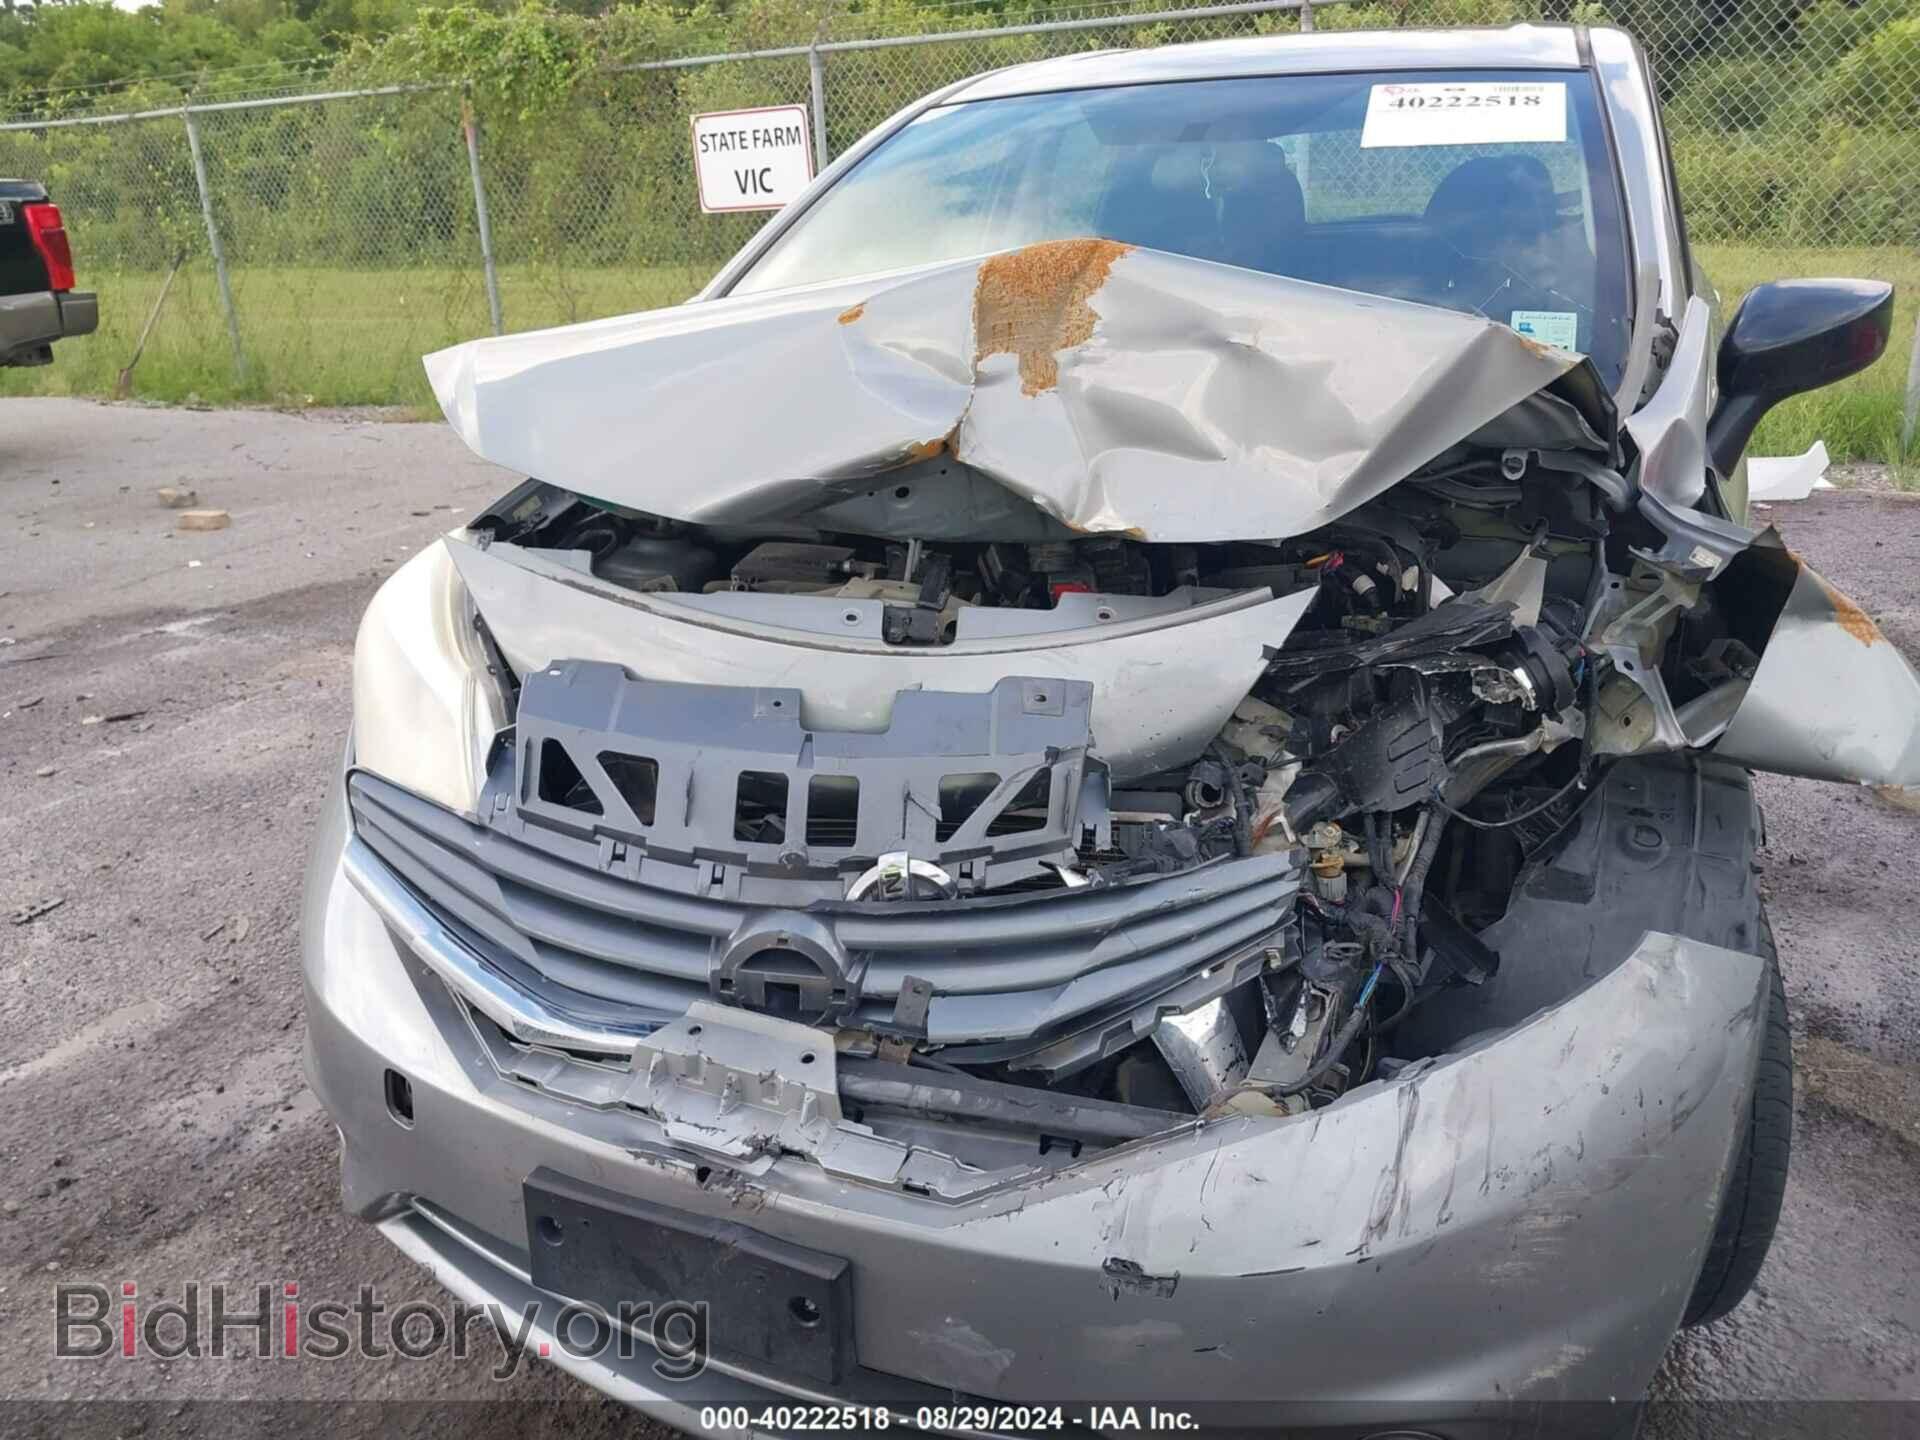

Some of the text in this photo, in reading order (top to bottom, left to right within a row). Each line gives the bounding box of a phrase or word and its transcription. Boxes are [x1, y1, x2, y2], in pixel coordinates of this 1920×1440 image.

[1389, 95, 1541, 109] 40222518
[700, 126, 801, 152] STATE FARM
[734, 167, 774, 194] VIC
